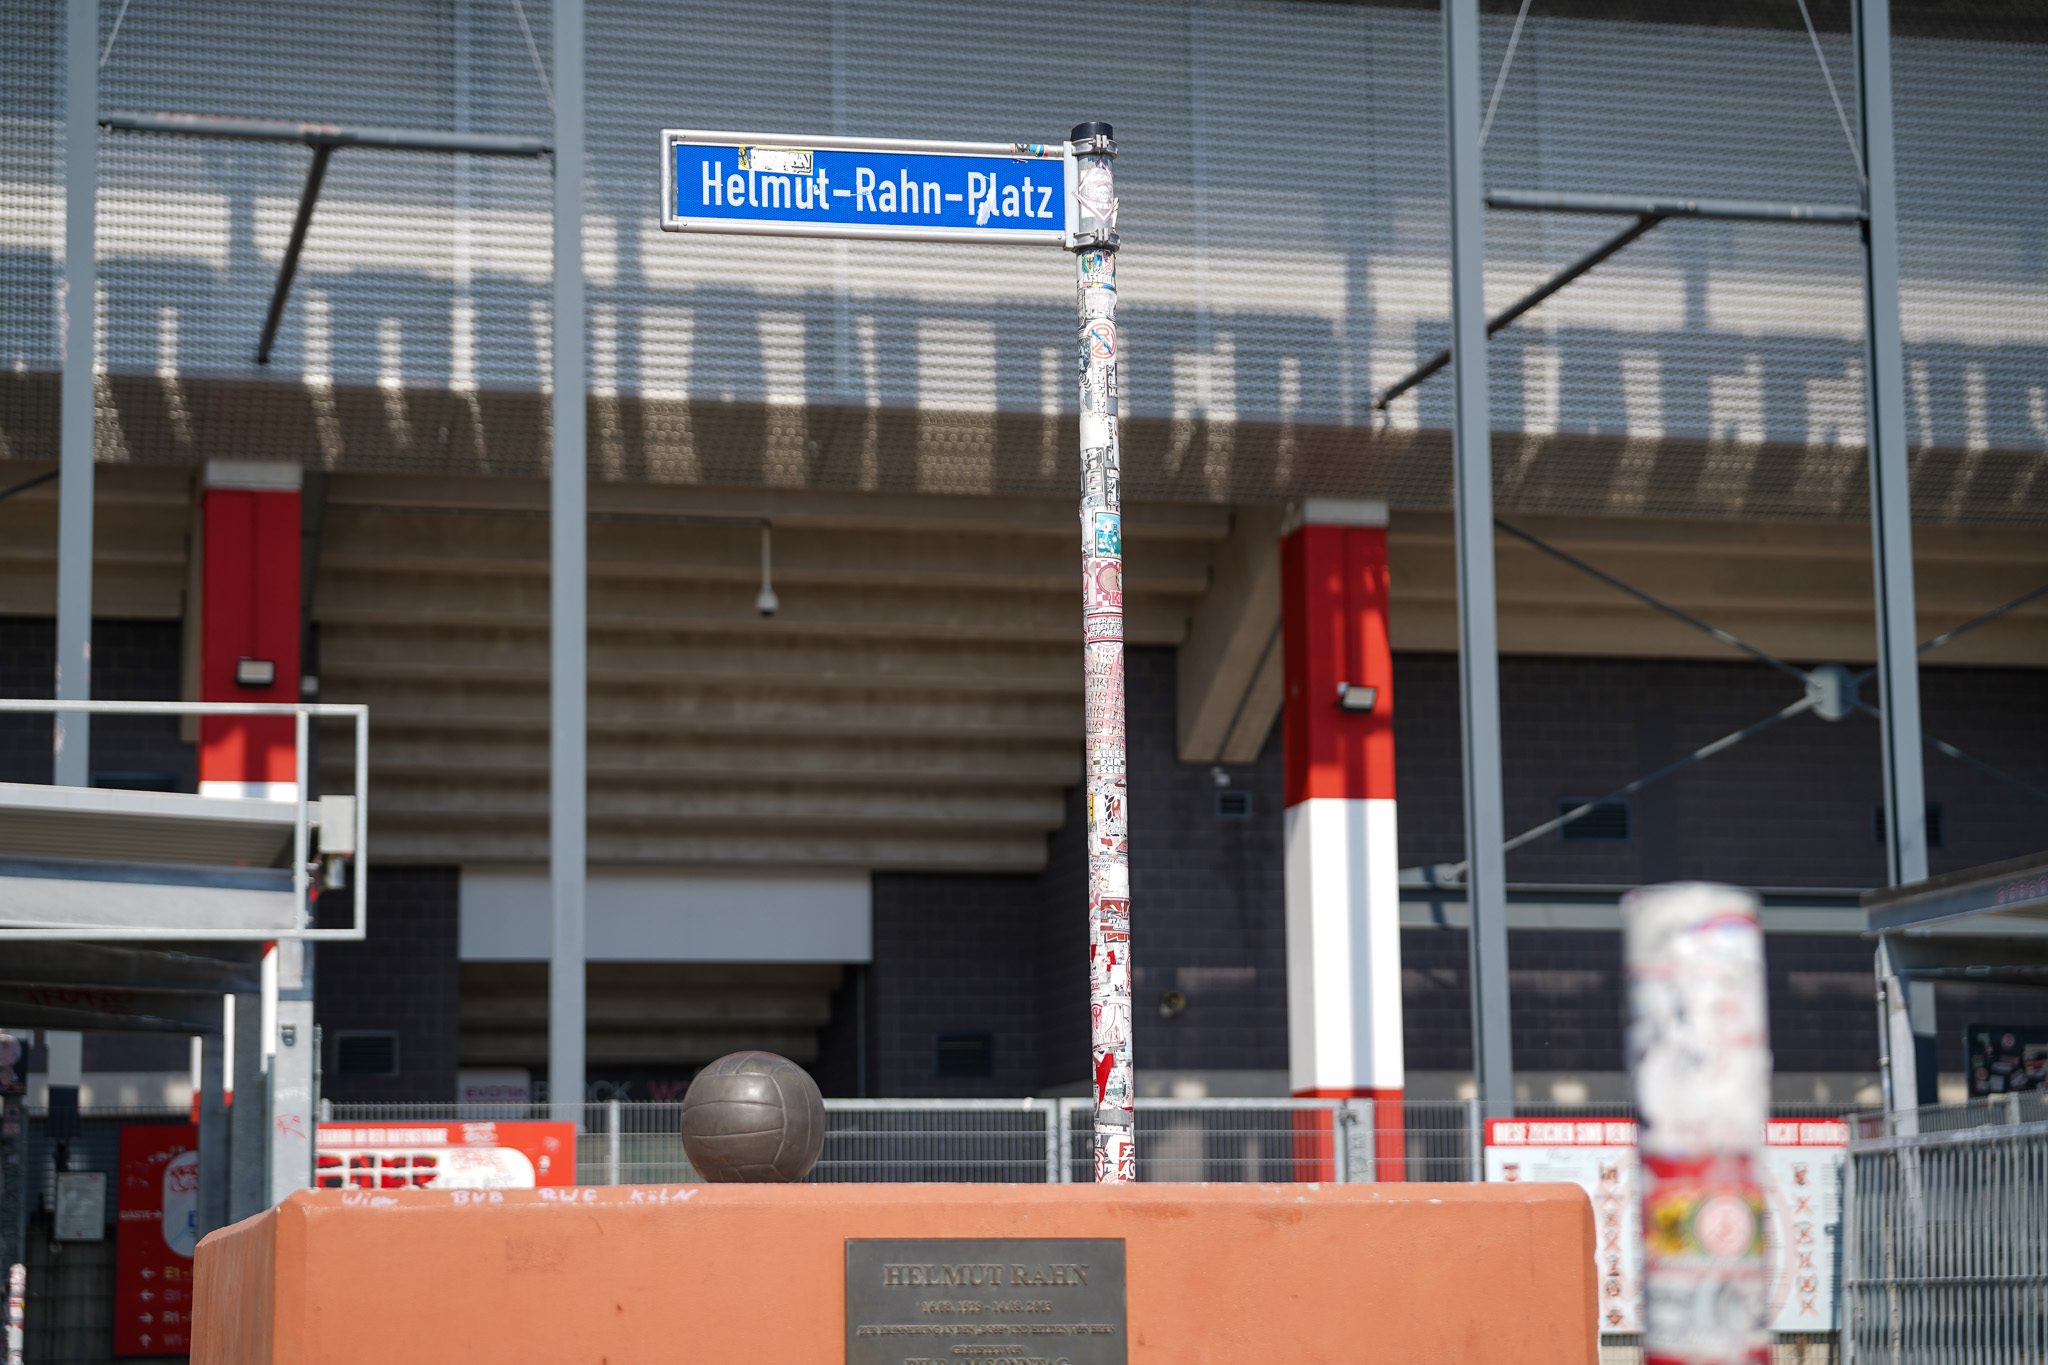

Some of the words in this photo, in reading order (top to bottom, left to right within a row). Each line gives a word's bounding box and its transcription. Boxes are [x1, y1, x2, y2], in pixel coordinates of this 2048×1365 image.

[701, 160, 1054, 219] Helmut-Rahn-Platz
[1094, 750, 1125, 758] ALLES
[1101, 757, 1121, 766] FÜR
[451, 1189, 504, 1205] BVB
[538, 1187, 598, 1202] RWE
[883, 1264, 1004, 1287] HELMUT
[1010, 1264, 1090, 1287] RAHN
